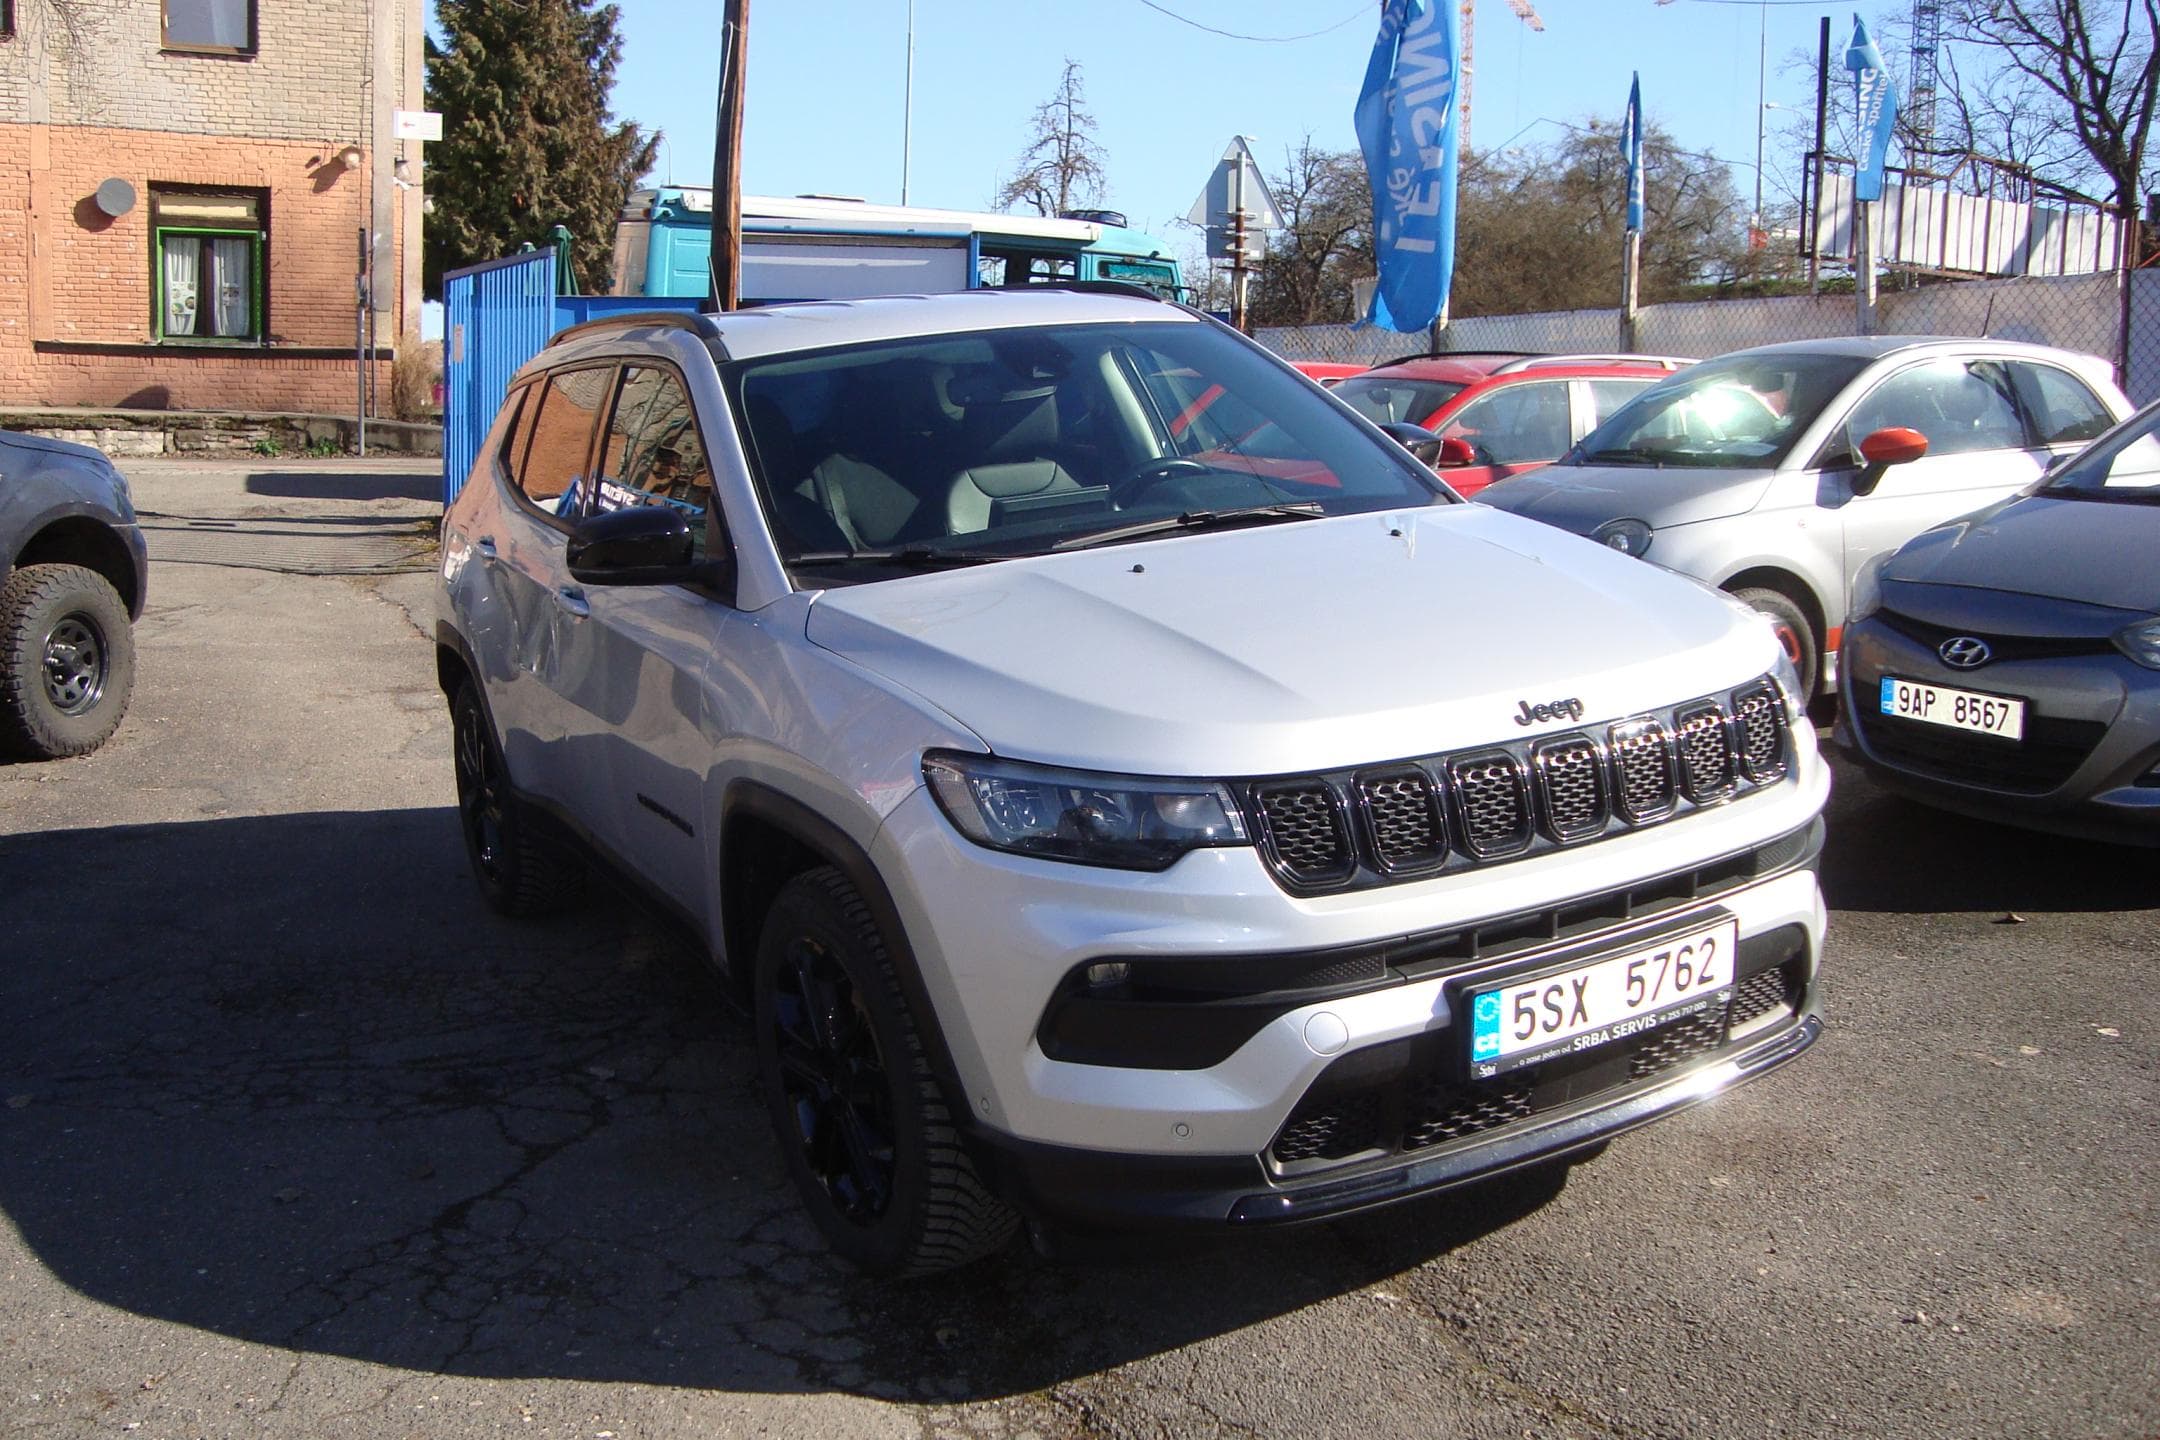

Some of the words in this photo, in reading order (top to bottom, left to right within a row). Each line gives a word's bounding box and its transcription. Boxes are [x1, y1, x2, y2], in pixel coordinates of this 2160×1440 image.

[1514, 698, 1584, 727] Jeep
[1899, 686, 1936, 717] 9AP
[1954, 695, 2009, 731] 8567
[1514, 975, 1589, 1041] 5SX
[1626, 937, 1716, 1008] 5762
[1475, 1032, 1499, 1053] CZ
[1573, 1030, 1610, 1051] SRBA
[1612, 1013, 1657, 1039] SERVIS
